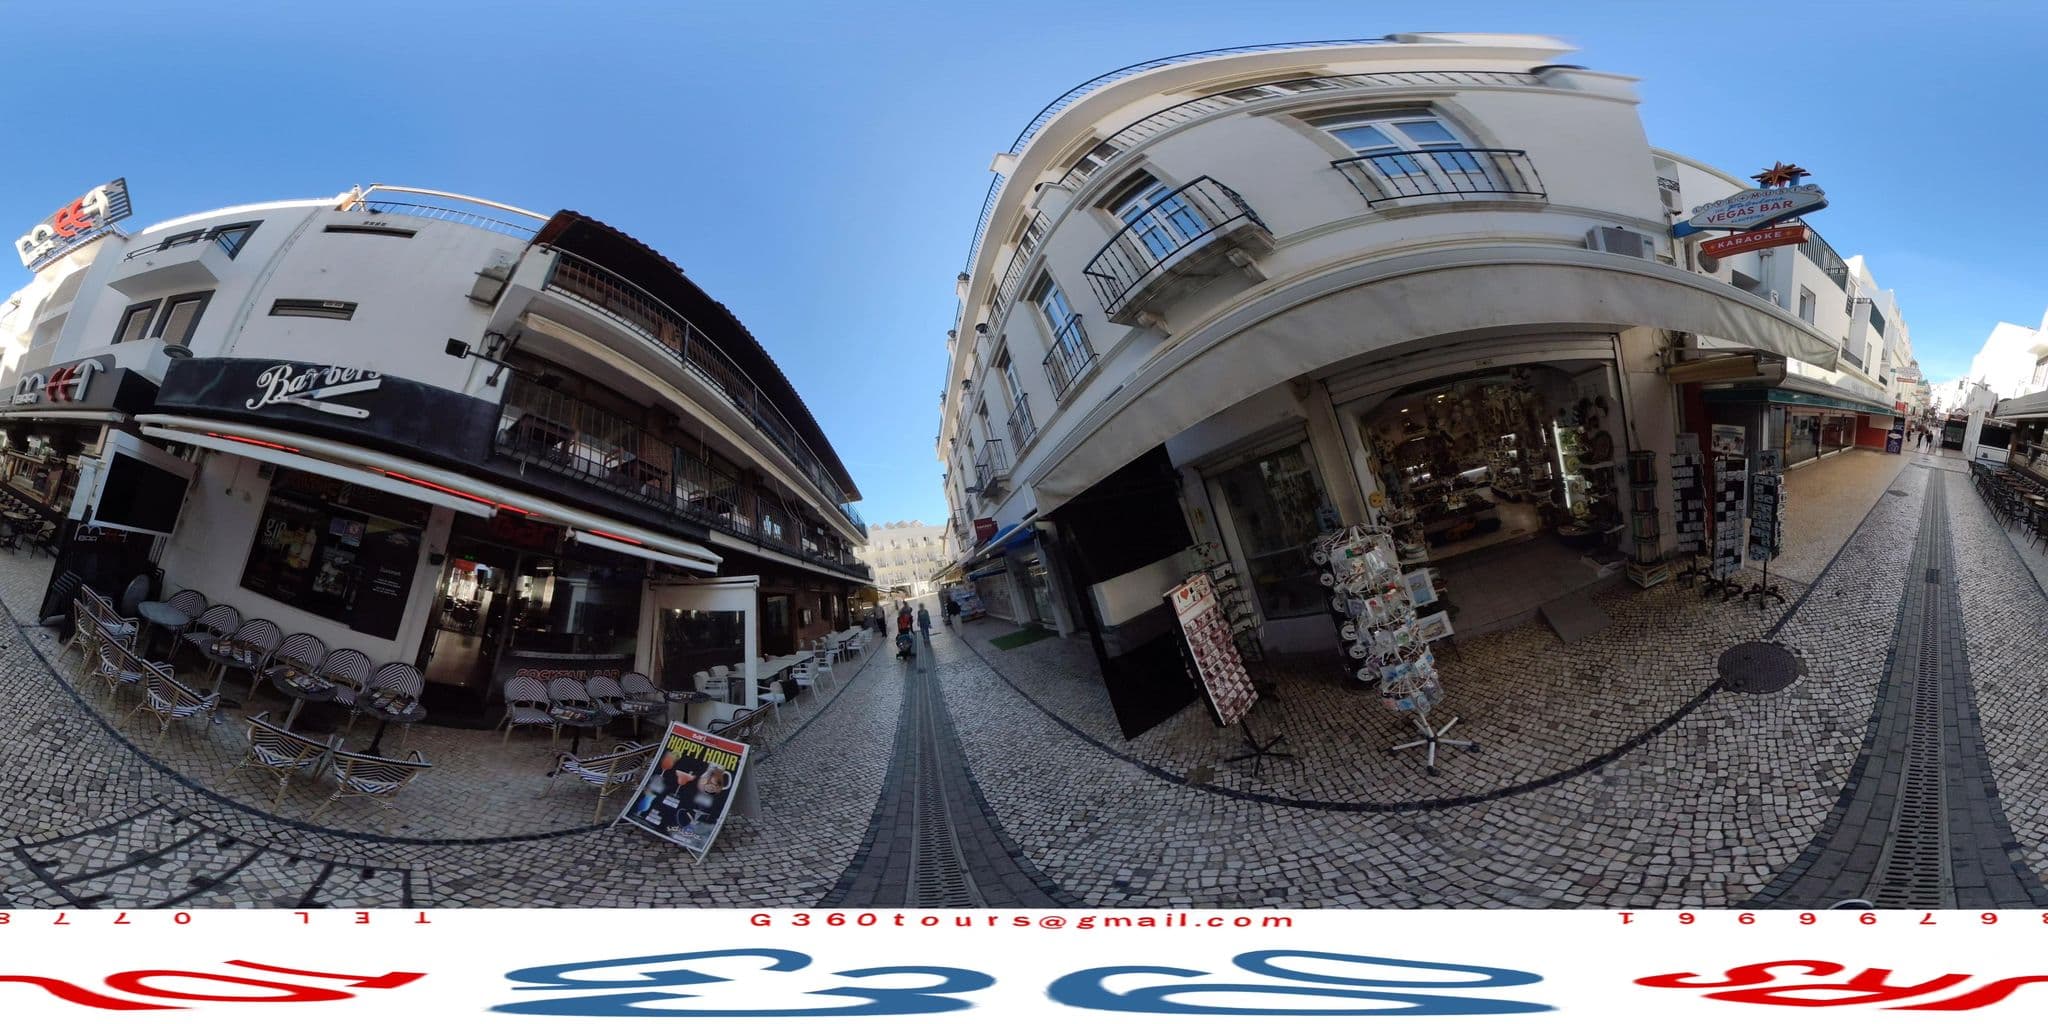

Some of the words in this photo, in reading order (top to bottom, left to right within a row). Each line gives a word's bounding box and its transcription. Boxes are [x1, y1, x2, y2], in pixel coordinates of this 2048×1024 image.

[1707, 206, 1755, 223] VEGAS
[1759, 200, 1794, 212] BAR
[1717, 231, 1782, 249] KARAOKE
[667, 735, 704, 760] HAPPY
[703, 747, 739, 771] HOUR
